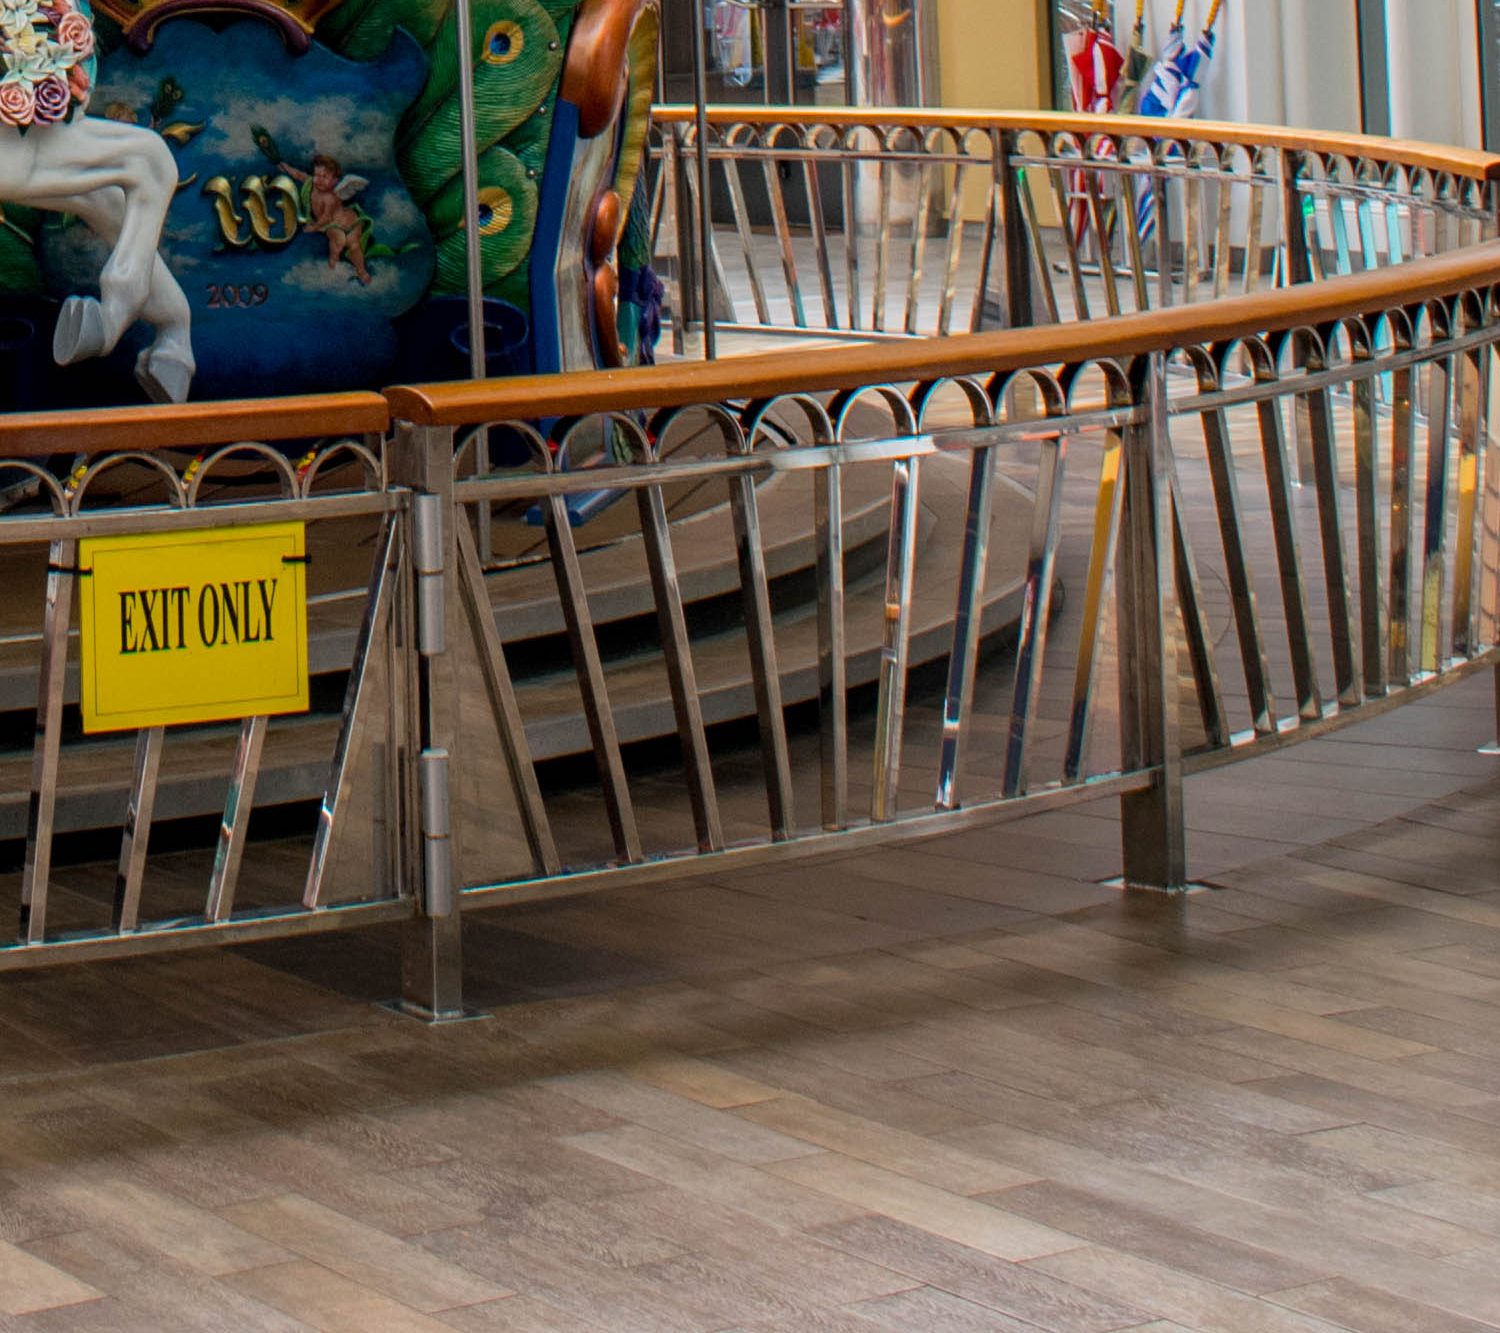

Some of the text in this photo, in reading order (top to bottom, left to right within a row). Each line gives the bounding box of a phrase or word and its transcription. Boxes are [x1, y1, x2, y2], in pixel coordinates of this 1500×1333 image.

[206, 283, 270, 309] 2009
[117, 577, 278, 655] EXIT ONLY
